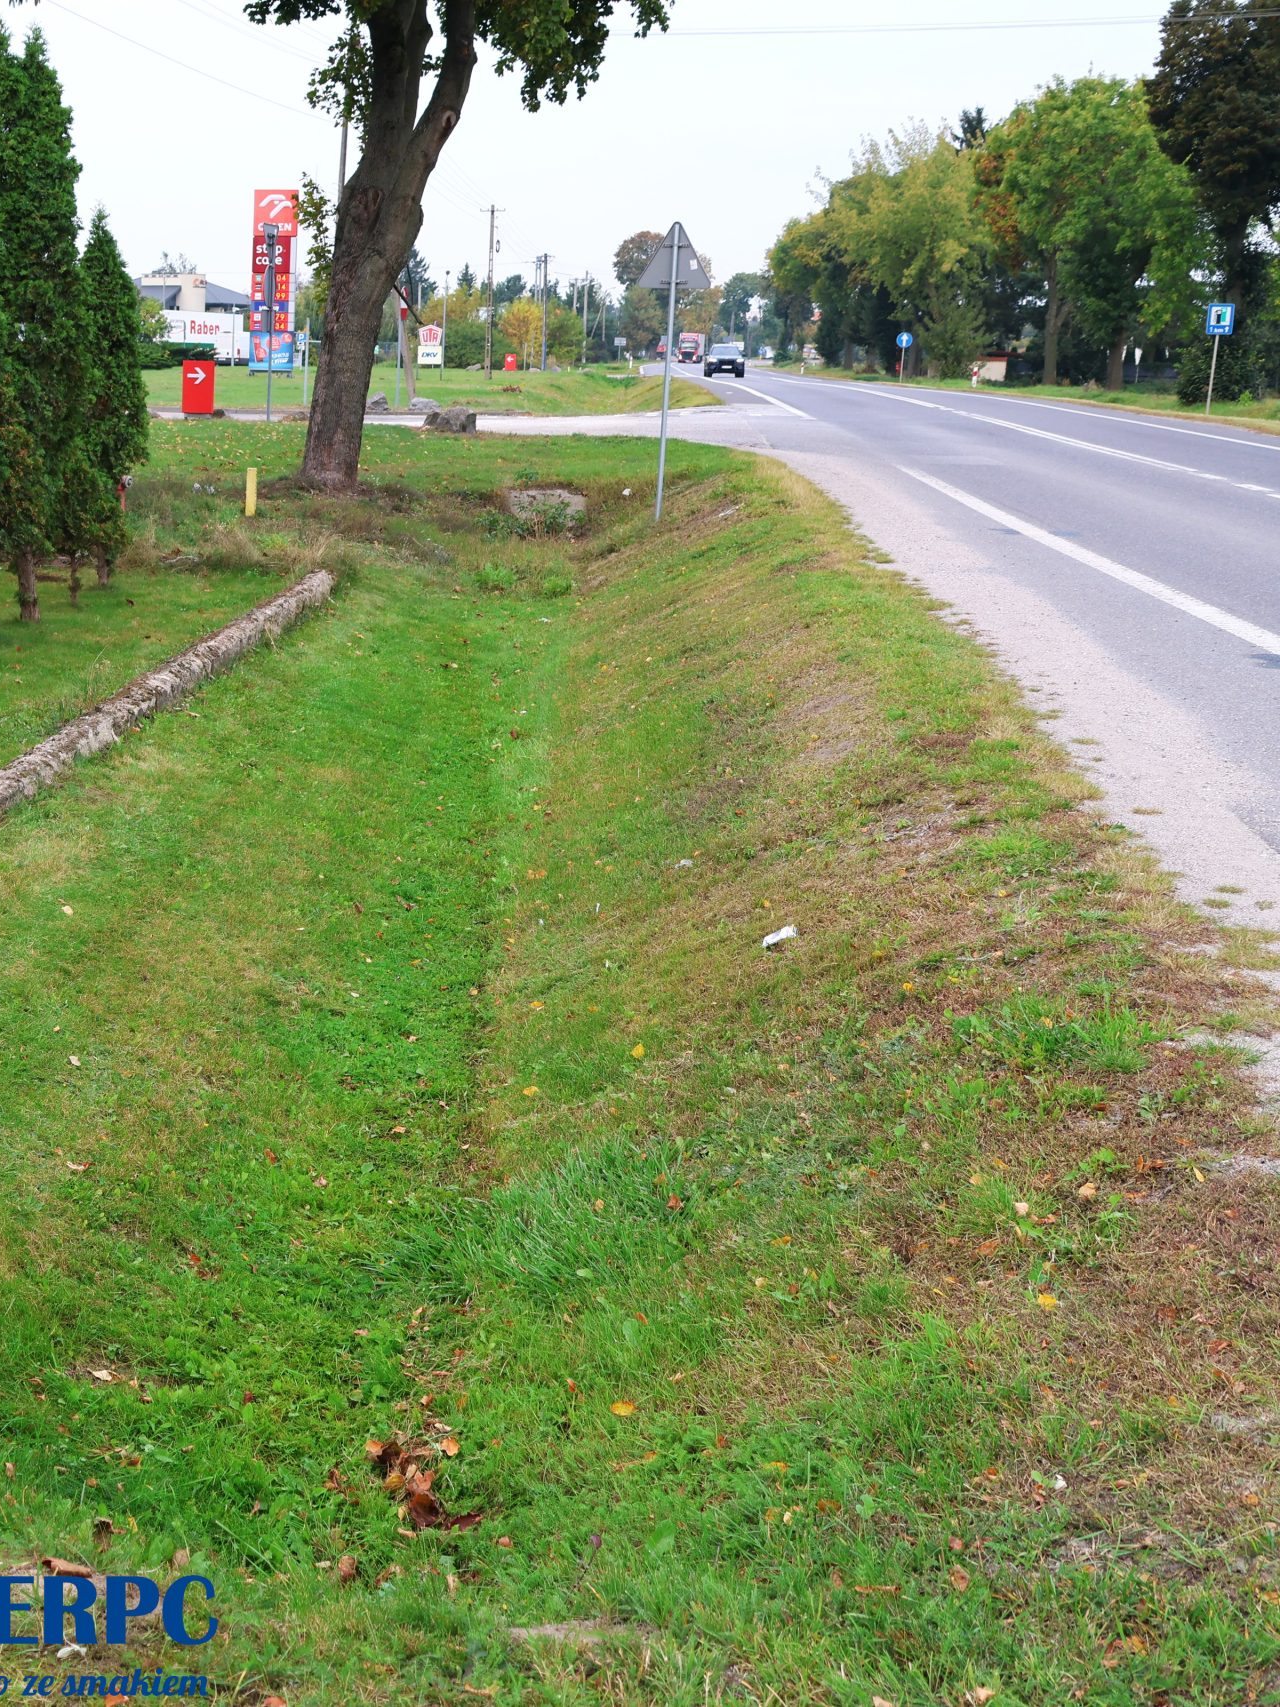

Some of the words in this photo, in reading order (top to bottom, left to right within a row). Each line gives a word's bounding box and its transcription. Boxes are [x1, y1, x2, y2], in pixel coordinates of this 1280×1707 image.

[258, 222, 292, 232] OEN
[256, 243, 283, 256] stp
[256, 256, 283, 265] cae
[422, 328, 439, 342] UTA
